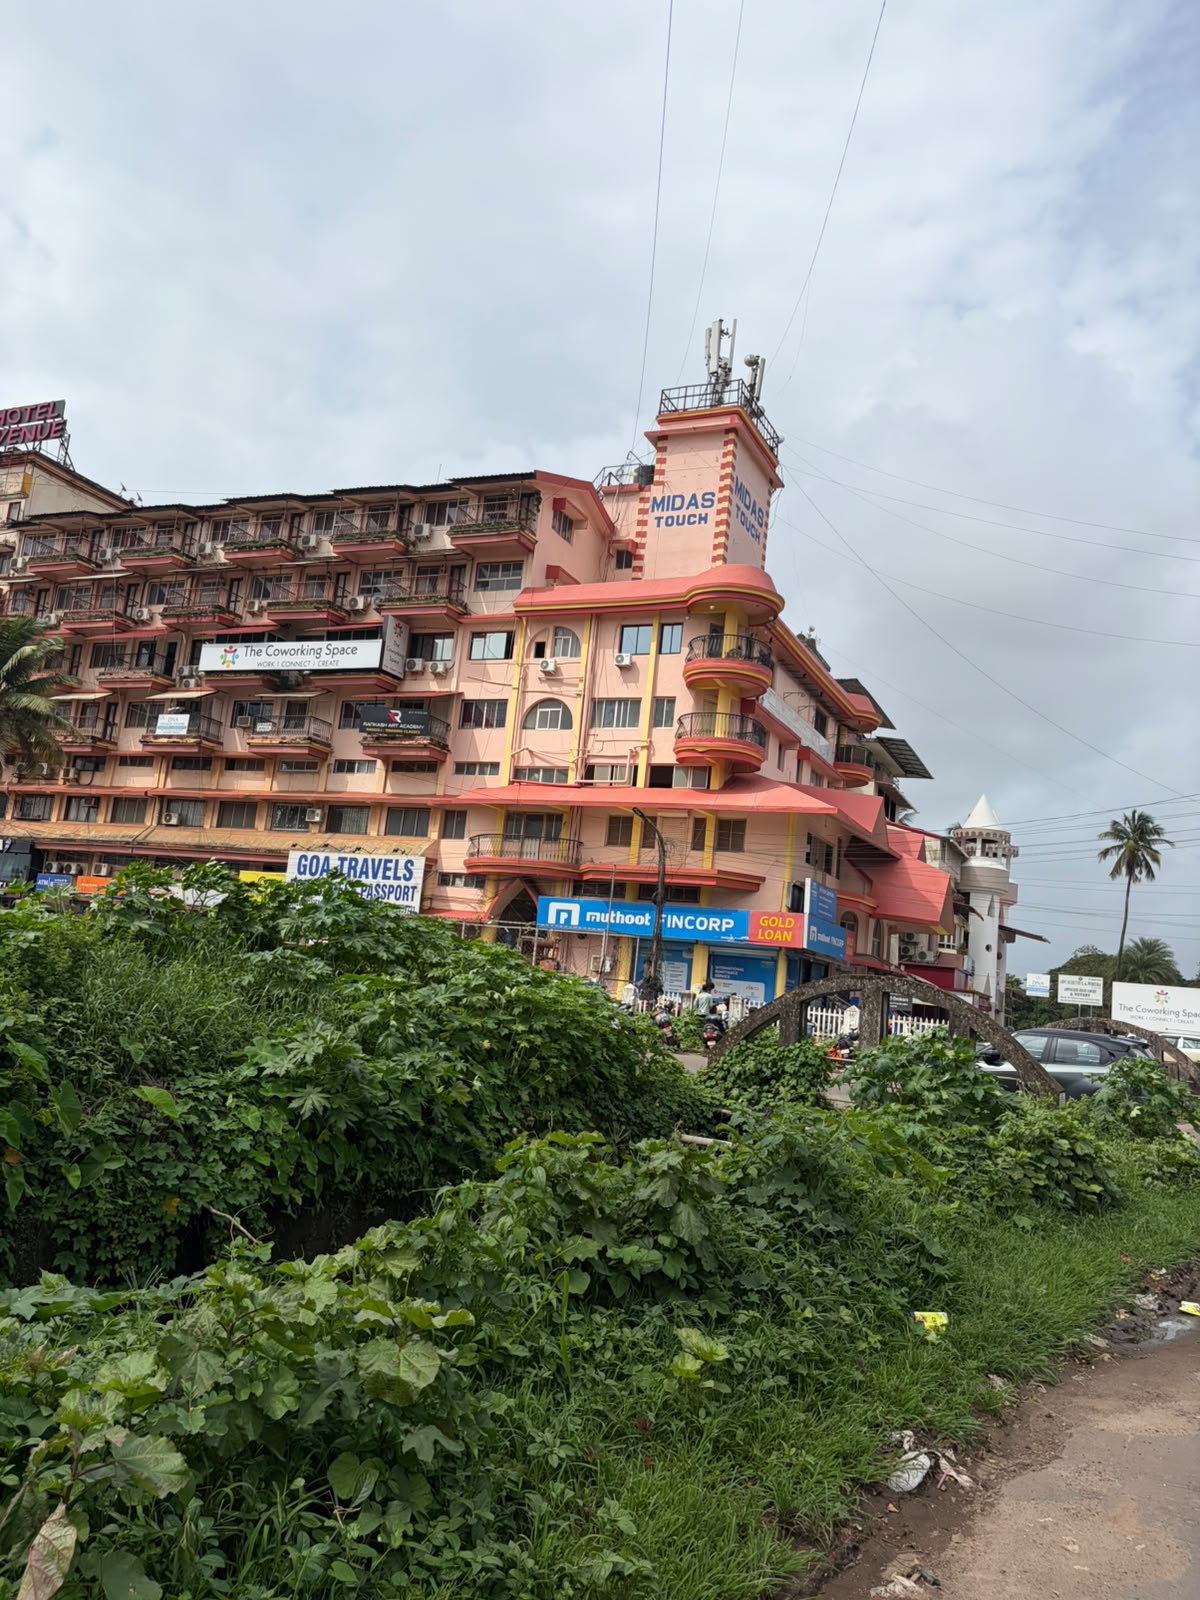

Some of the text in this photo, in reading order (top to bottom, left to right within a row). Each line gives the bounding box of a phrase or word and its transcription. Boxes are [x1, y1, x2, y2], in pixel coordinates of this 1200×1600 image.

[651, 492, 716, 513] MIDAS
[735, 475, 764, 528] MIDAS
[654, 513, 708, 528] TOUCH
[736, 503, 760, 545] TOUCH
[244, 643, 358, 660] The Coworking Space
[297, 854, 414, 882] GOA TRAVELS
[361, 883, 417, 902] PASSPORT
[585, 910, 651, 926] muthoot
[759, 915, 795, 929] GOLD
[757, 929, 793, 942] LOAN
[1119, 1003, 1133, 1012] The
[1135, 1005, 1180, 1018] Coworking
